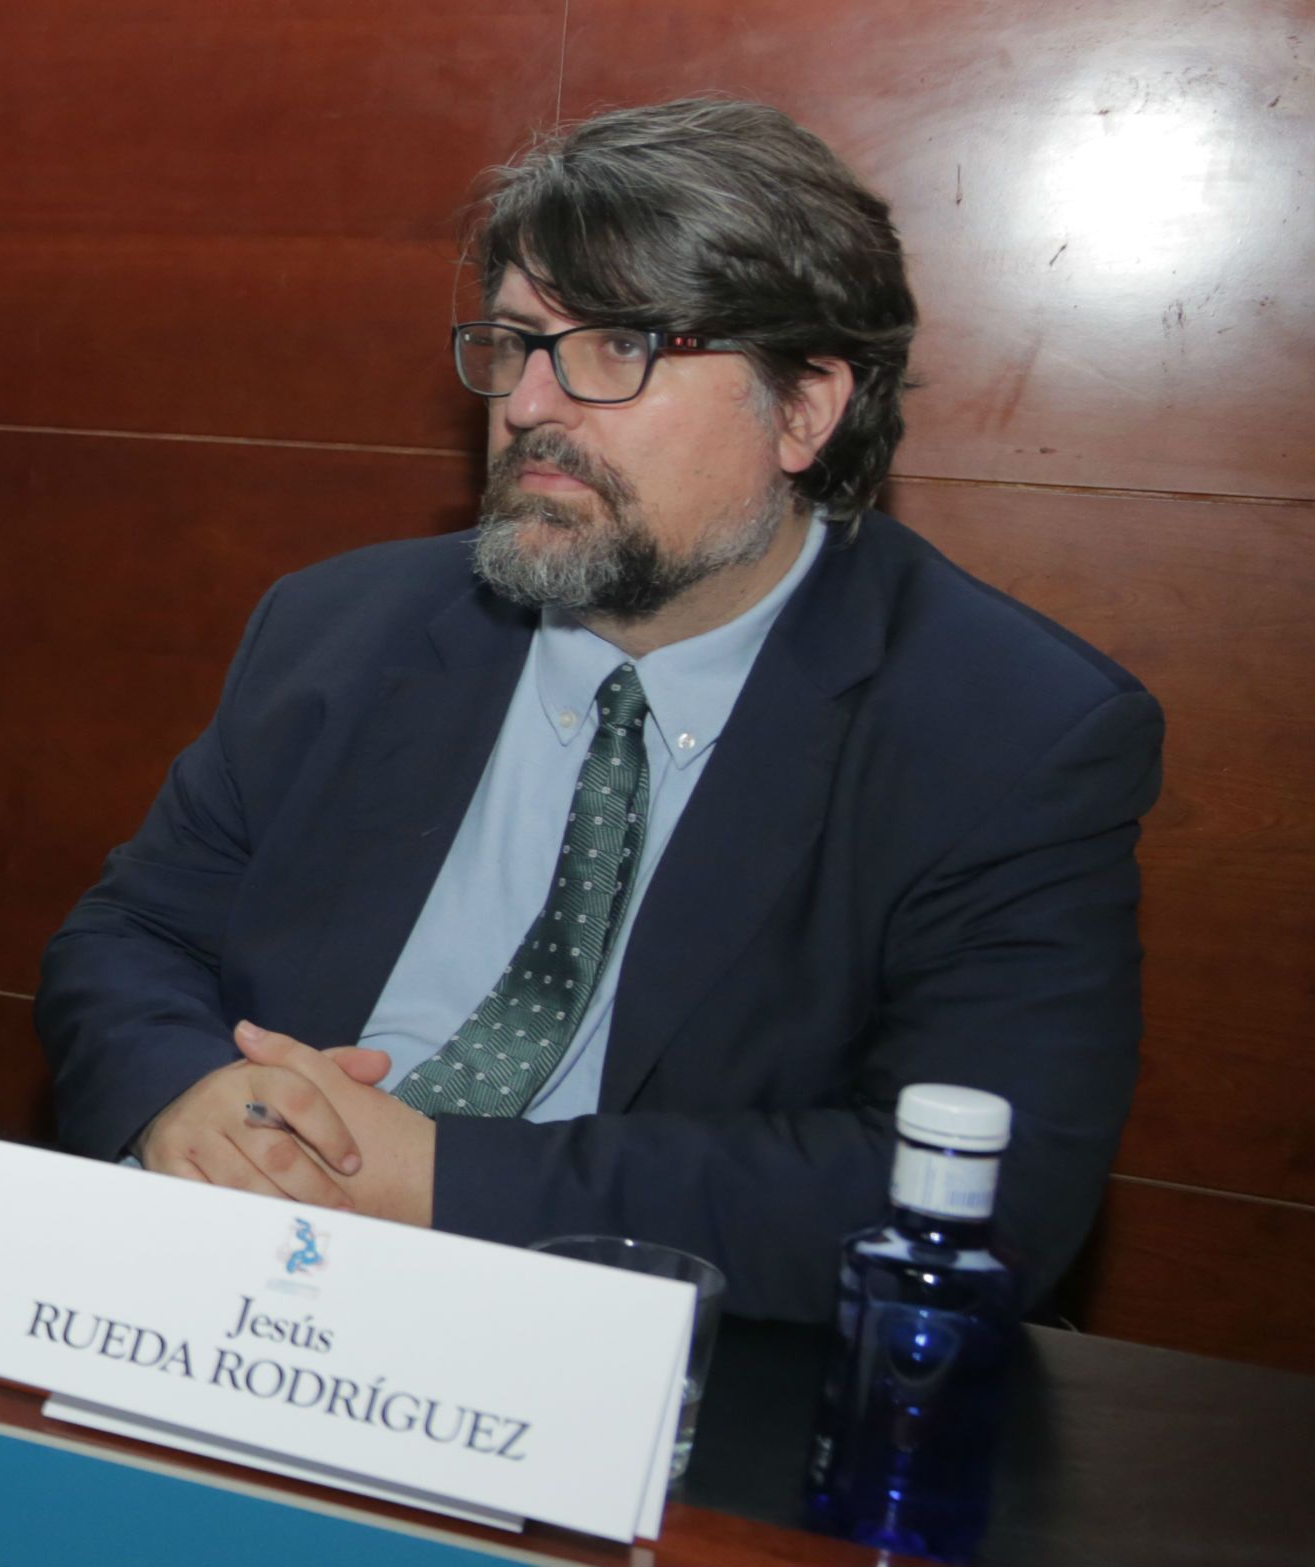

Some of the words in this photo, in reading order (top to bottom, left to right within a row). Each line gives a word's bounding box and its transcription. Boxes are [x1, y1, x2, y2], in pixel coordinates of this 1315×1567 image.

[226, 1296, 335, 1353] Jesús
[27, 1299, 195, 1380] RUEDA
[209, 1347, 531, 1461] RODRÍGUEZ
